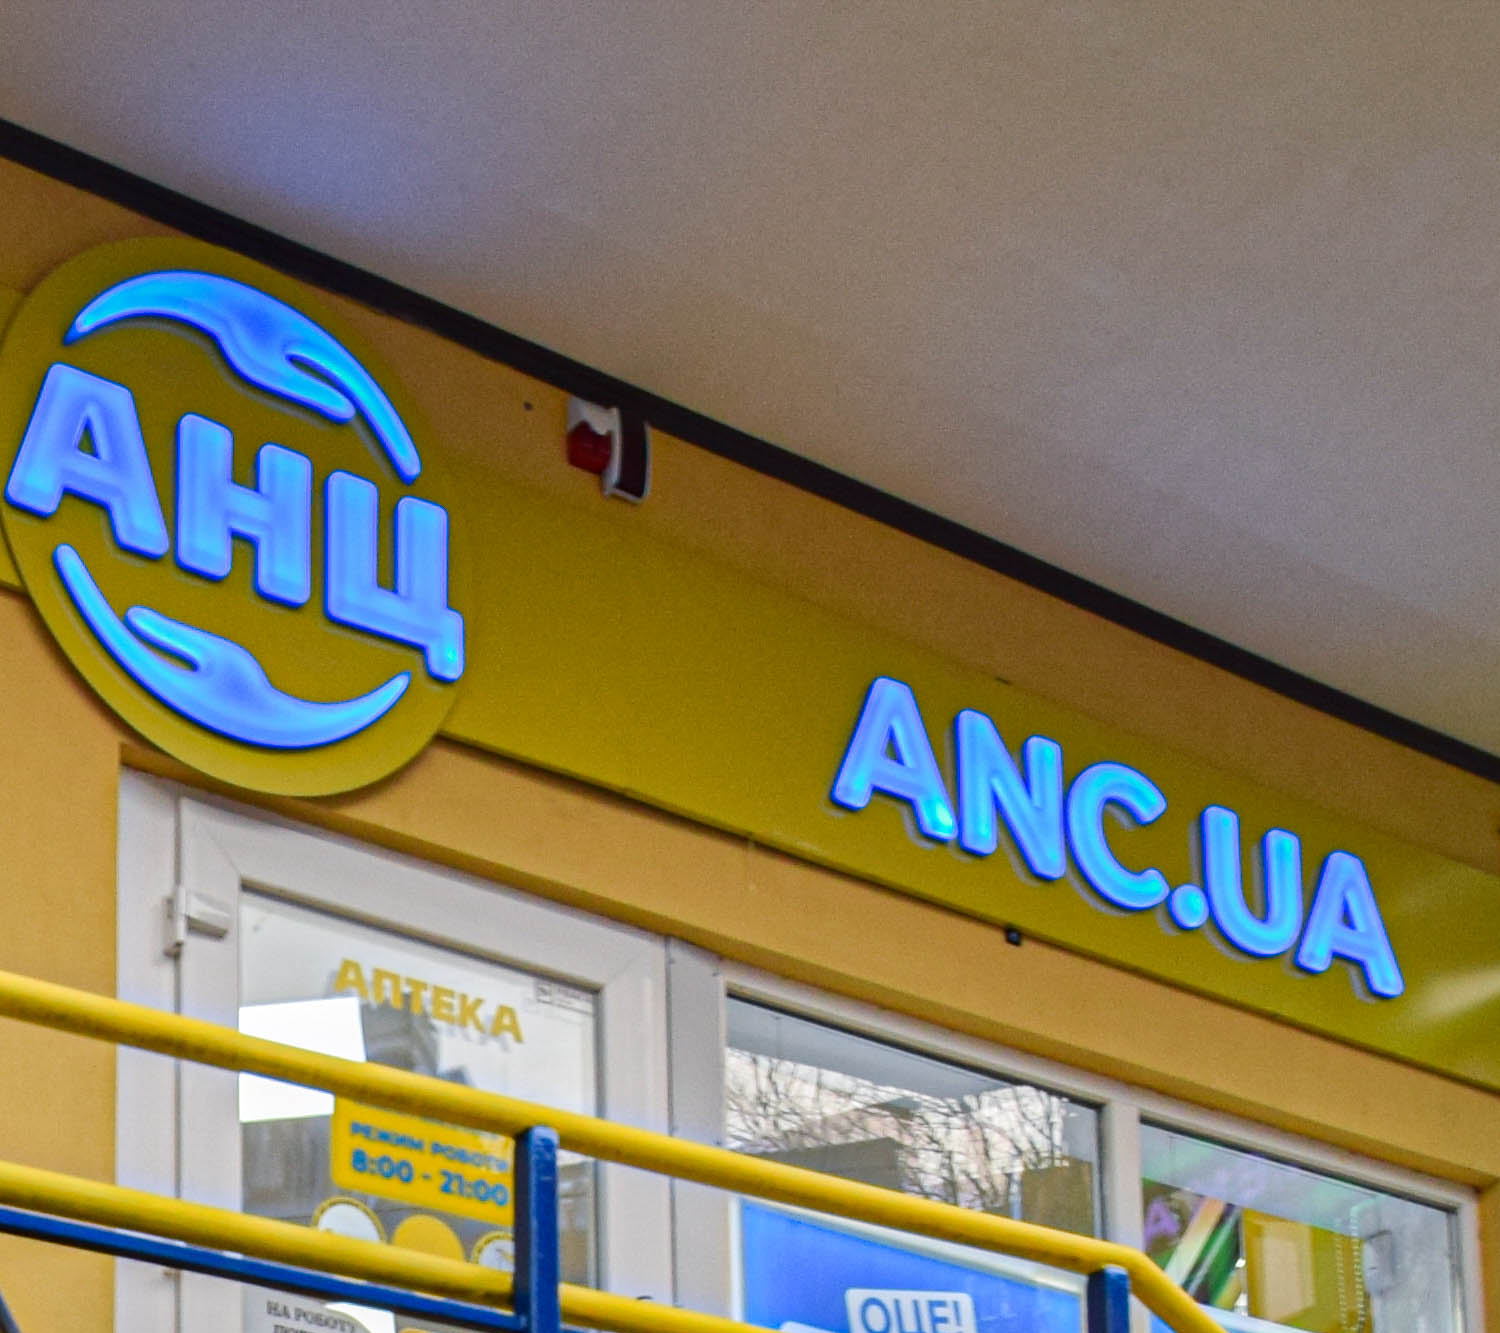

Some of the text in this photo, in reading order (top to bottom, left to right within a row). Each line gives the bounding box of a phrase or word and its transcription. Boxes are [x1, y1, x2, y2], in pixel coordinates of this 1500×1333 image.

[4, 361, 465, 683] АНЦ
[830, 675, 1406, 999] ANC.UA
[333, 957, 525, 1045] АПТЕКА
[351, 1147, 415, 1184] 8:00
[439, 1168, 510, 1207] 21:00
